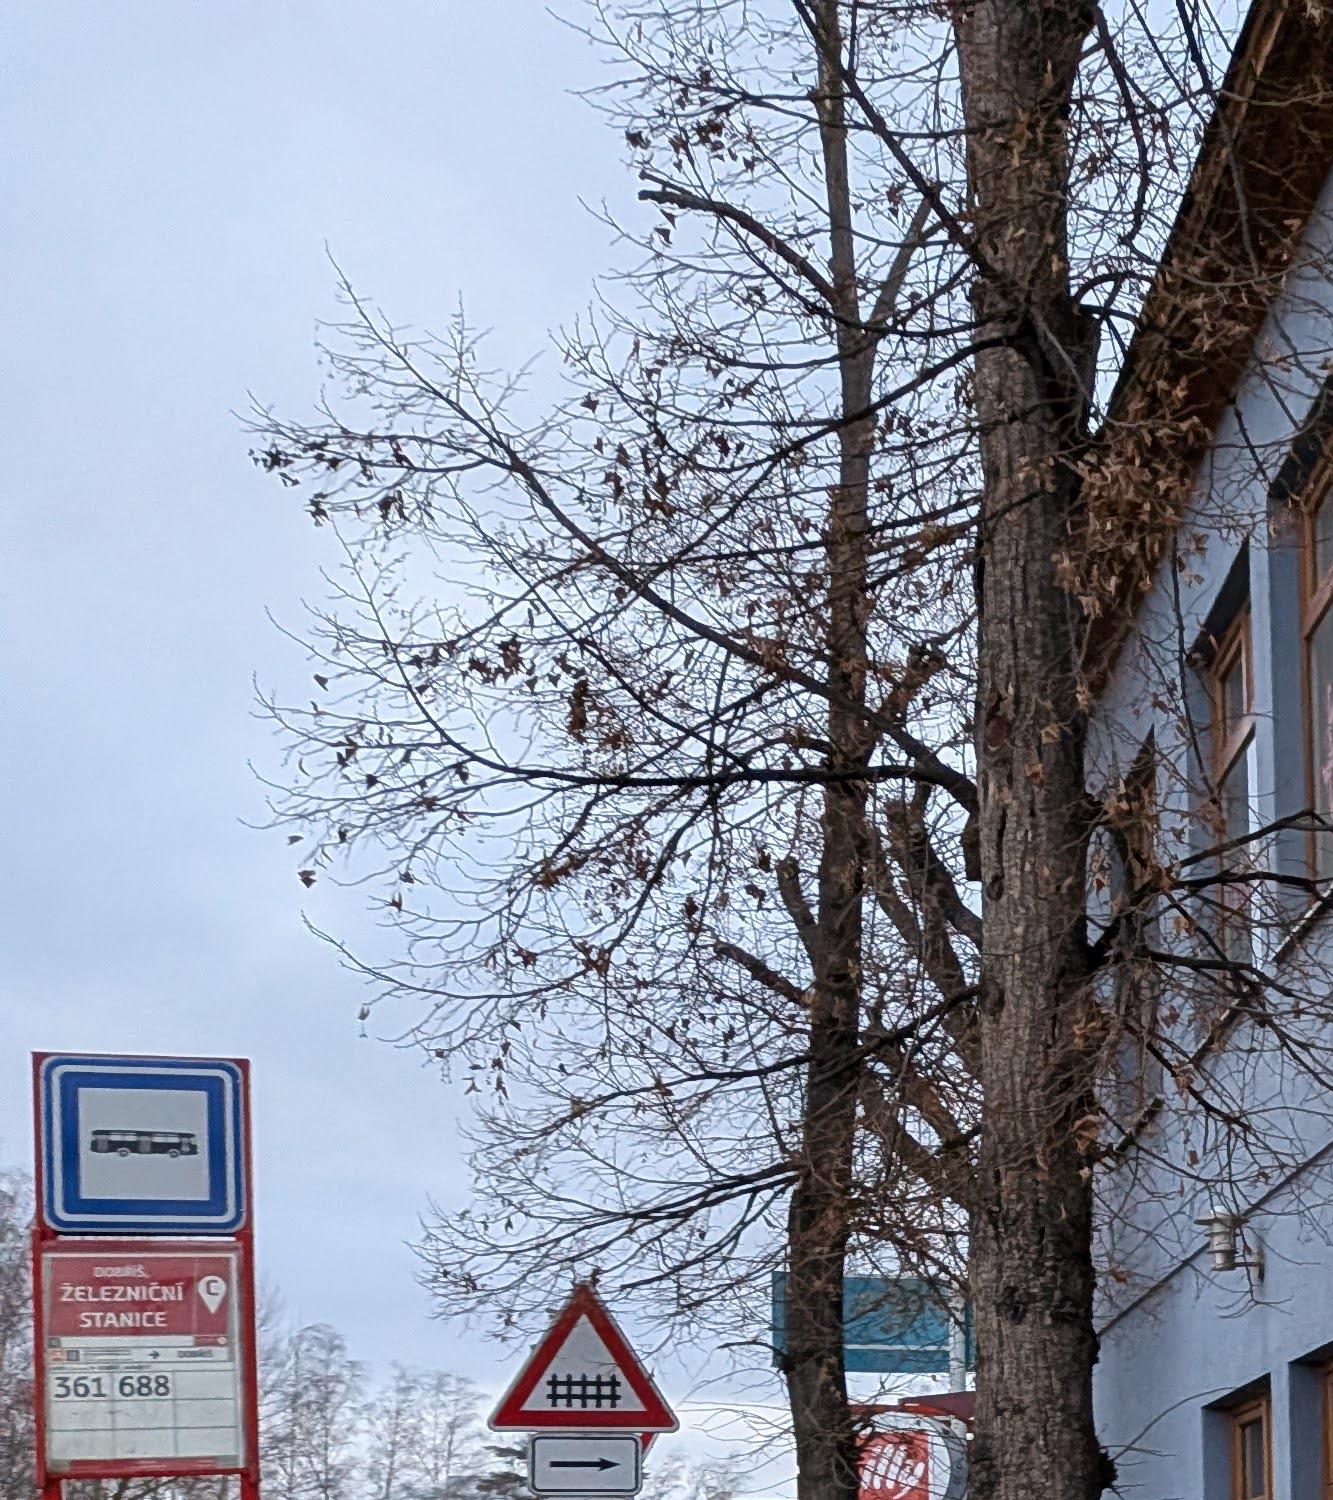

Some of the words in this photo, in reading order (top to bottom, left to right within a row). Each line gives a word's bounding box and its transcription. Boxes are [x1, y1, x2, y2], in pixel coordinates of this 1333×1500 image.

[60, 1282, 185, 1302] ŽELEZNIČNÍ
[79, 1311, 168, 1328] STANICE
[53, 1375, 107, 1399] 361
[118, 1374, 171, 1398] 688
